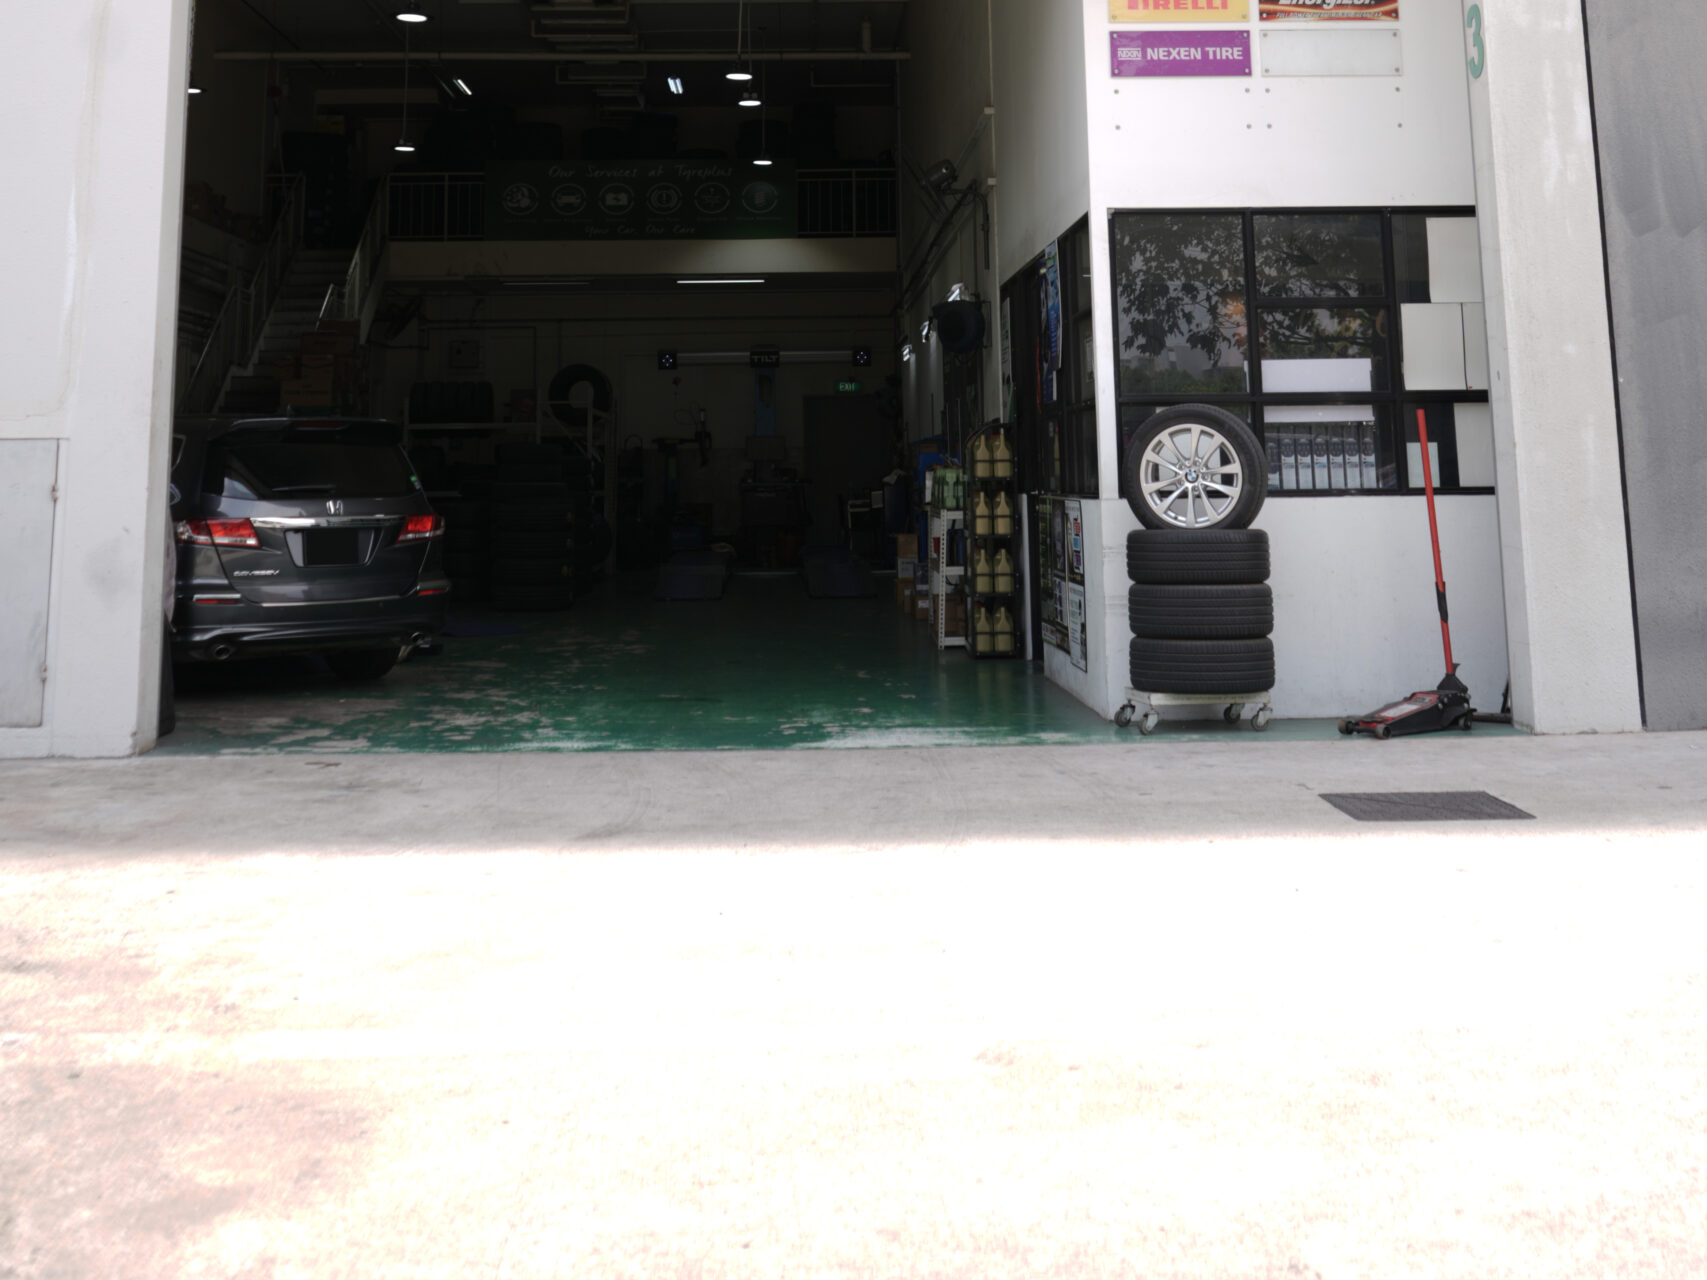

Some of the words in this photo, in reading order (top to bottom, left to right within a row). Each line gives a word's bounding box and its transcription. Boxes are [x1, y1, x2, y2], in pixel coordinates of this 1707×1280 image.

[1147, 48, 1201, 60] NEXEN
[1205, 47, 1243, 60] TIRE
[548, 165, 576, 178] Our
[585, 164, 639, 178] Services
[648, 164, 665, 177] at
[674, 164, 733, 181] Tyreplus
[839, 382, 856, 392] EXIT
